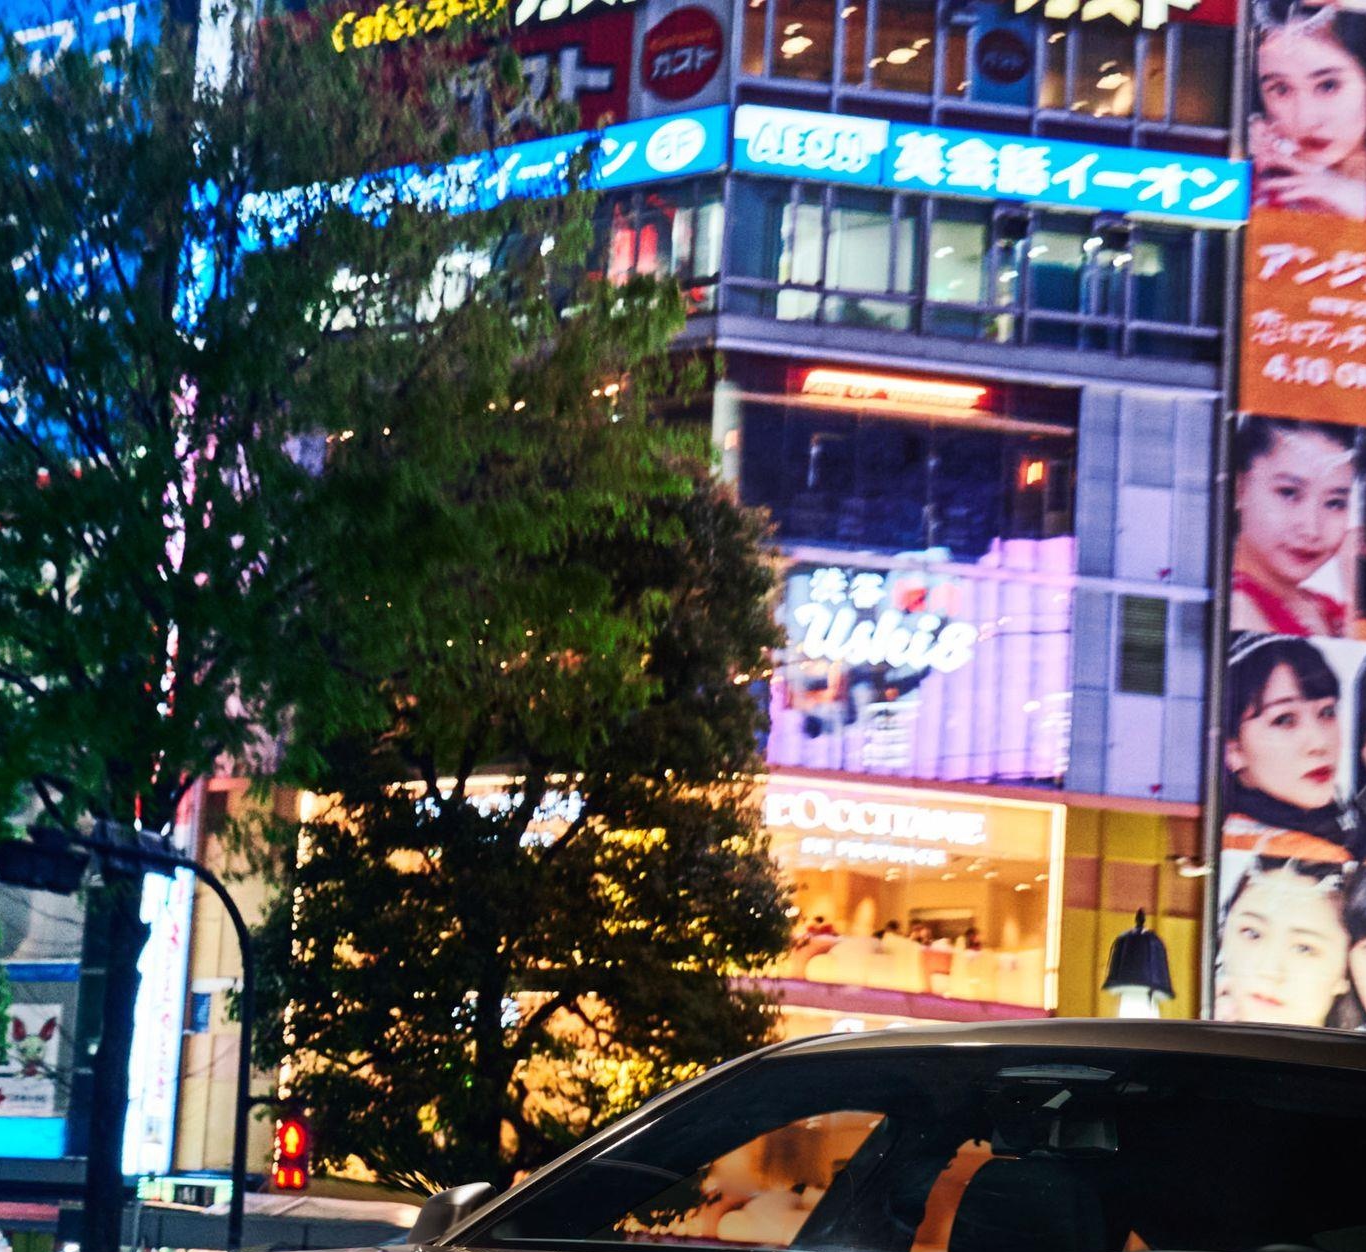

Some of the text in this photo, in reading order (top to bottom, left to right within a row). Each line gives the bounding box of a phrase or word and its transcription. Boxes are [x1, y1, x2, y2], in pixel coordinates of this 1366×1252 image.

[749, 121, 1240, 211] AEON 英会話イーオン
[1262, 353, 1331, 387] 4.10
